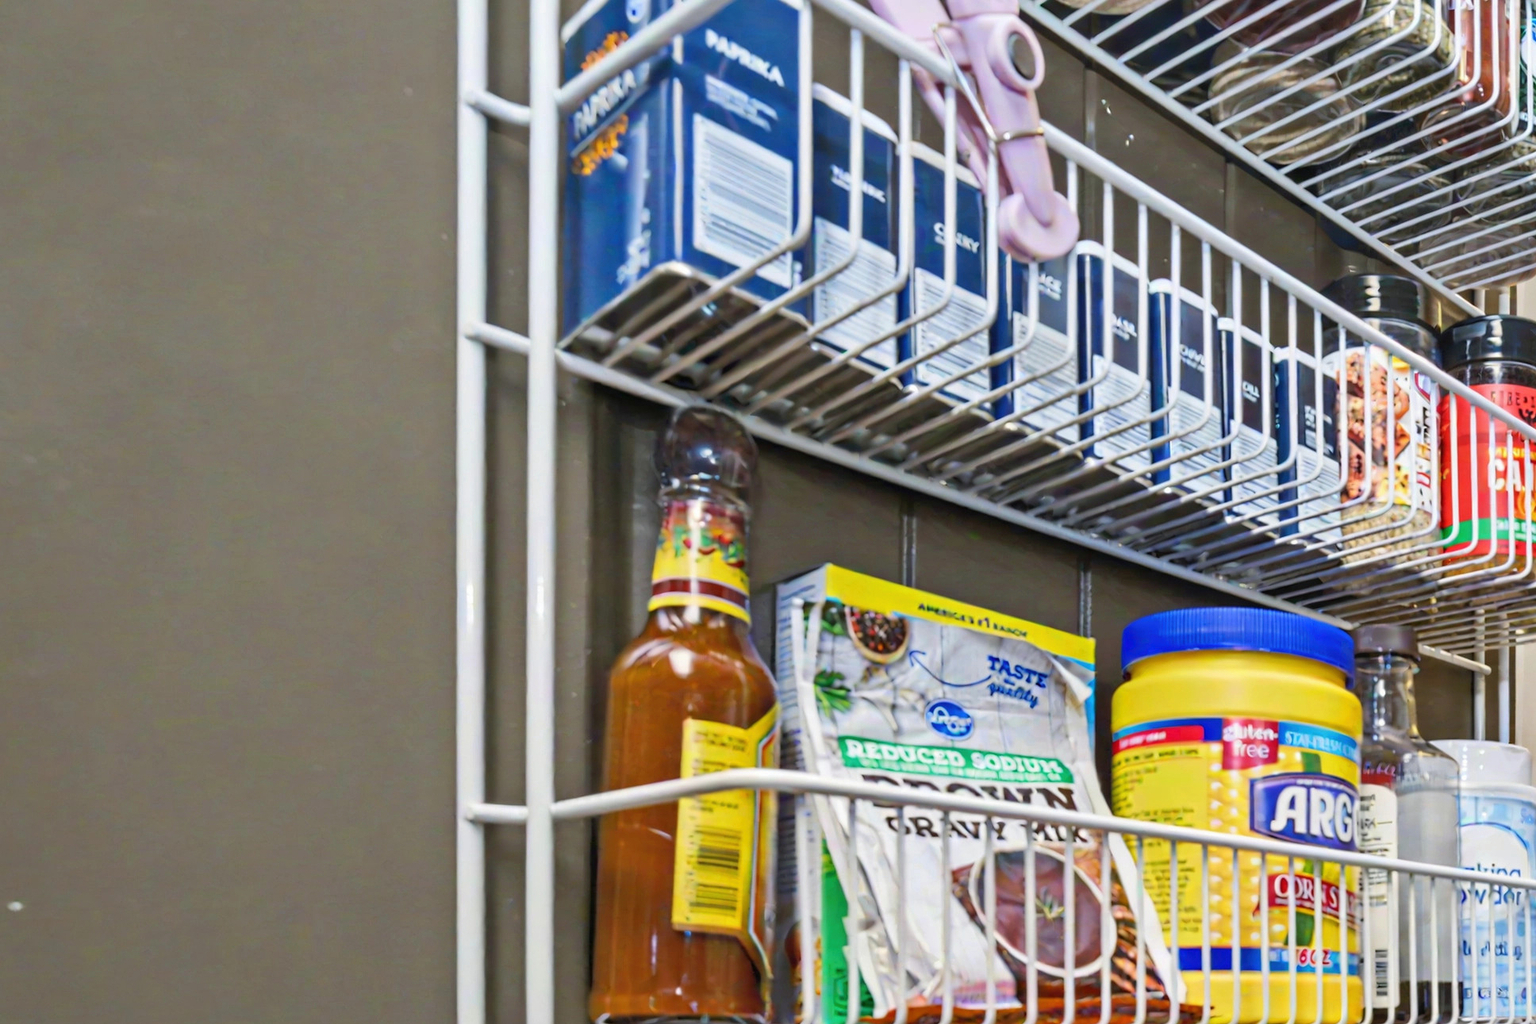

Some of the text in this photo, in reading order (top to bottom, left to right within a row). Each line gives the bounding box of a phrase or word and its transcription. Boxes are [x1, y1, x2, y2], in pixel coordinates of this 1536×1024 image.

[986, 654, 1049, 690] TASTE
[844, 738, 966, 768] REDUCED
[970, 751, 1064, 775] SODIUM
[1232, 740, 1270, 759] free
